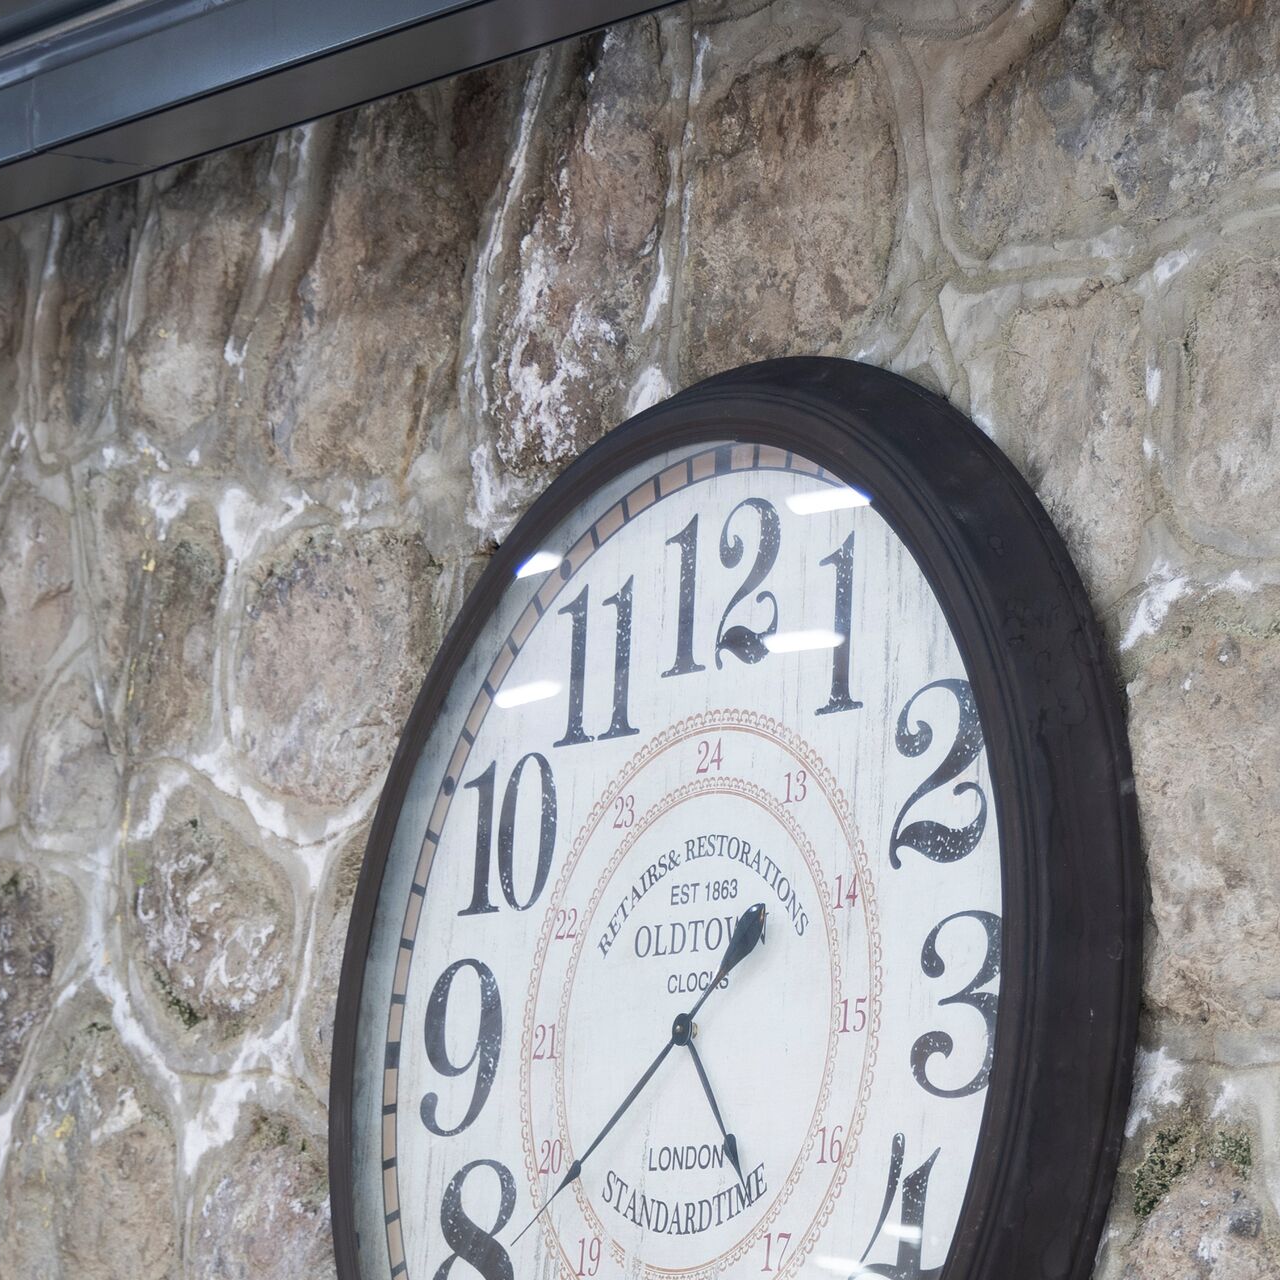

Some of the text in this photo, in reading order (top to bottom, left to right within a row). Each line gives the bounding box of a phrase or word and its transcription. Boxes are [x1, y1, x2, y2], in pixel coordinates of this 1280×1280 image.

[661, 497, 782, 678] 12
[815, 530, 863, 716] 1
[553, 575, 640, 748] 11
[696, 738, 723, 774] 24
[889, 678, 988, 869] 2
[783, 770, 808, 803] 13
[613, 794, 635, 830] 23
[457, 752, 558, 916] 10
[670, 878, 738, 906] EST 1863
[684, 834, 809, 937] RESTORATIONS
[833, 874, 858, 909] 14
[554, 908, 578, 940] 22
[839, 998, 867, 1033] 15
[910, 910, 1002, 1098] 3
[420, 958, 503, 1137] 9
[532, 1024, 558, 1060] 21
[538, 1139, 563, 1175] 20
[648, 1144, 724, 1172] LONDON
[817, 1125, 843, 1165] 16
[577, 1237, 602, 1277] 19
[762, 1232, 792, 1272] 17
